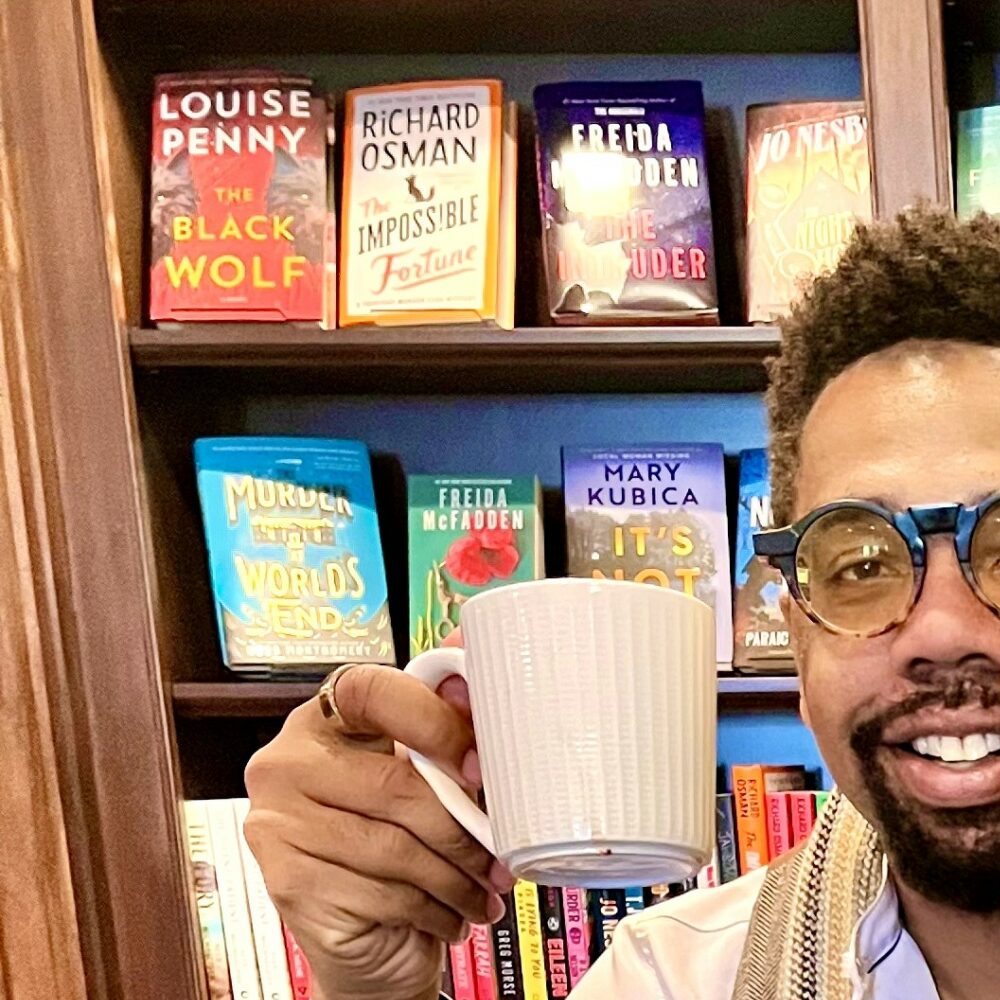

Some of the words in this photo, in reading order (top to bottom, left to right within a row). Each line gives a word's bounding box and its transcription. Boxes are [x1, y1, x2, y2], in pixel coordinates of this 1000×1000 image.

[159, 89, 312, 121] LOUISE
[161, 126, 307, 157] PENNY
[571, 122, 673, 152] FREIDA
[360, 136, 477, 172] OSMAN
[754, 129, 791, 176] JO
[214, 186, 253, 203] THE
[172, 215, 295, 242] BLACK
[164, 255, 307, 290] WOLF
[370, 244, 479, 297] Fortune
[604, 462, 681, 482] MARY
[438, 487, 508, 509] FREIDA
[587, 487, 699, 506] KUBICA
[422, 509, 525, 532] McFADDEN
[613, 525, 695, 557] IT'S
[267, 598, 344, 639] END
[600, 896, 619, 916] JO
[497, 929, 513, 958] GREG
[547, 937, 568, 998] EILEEN
